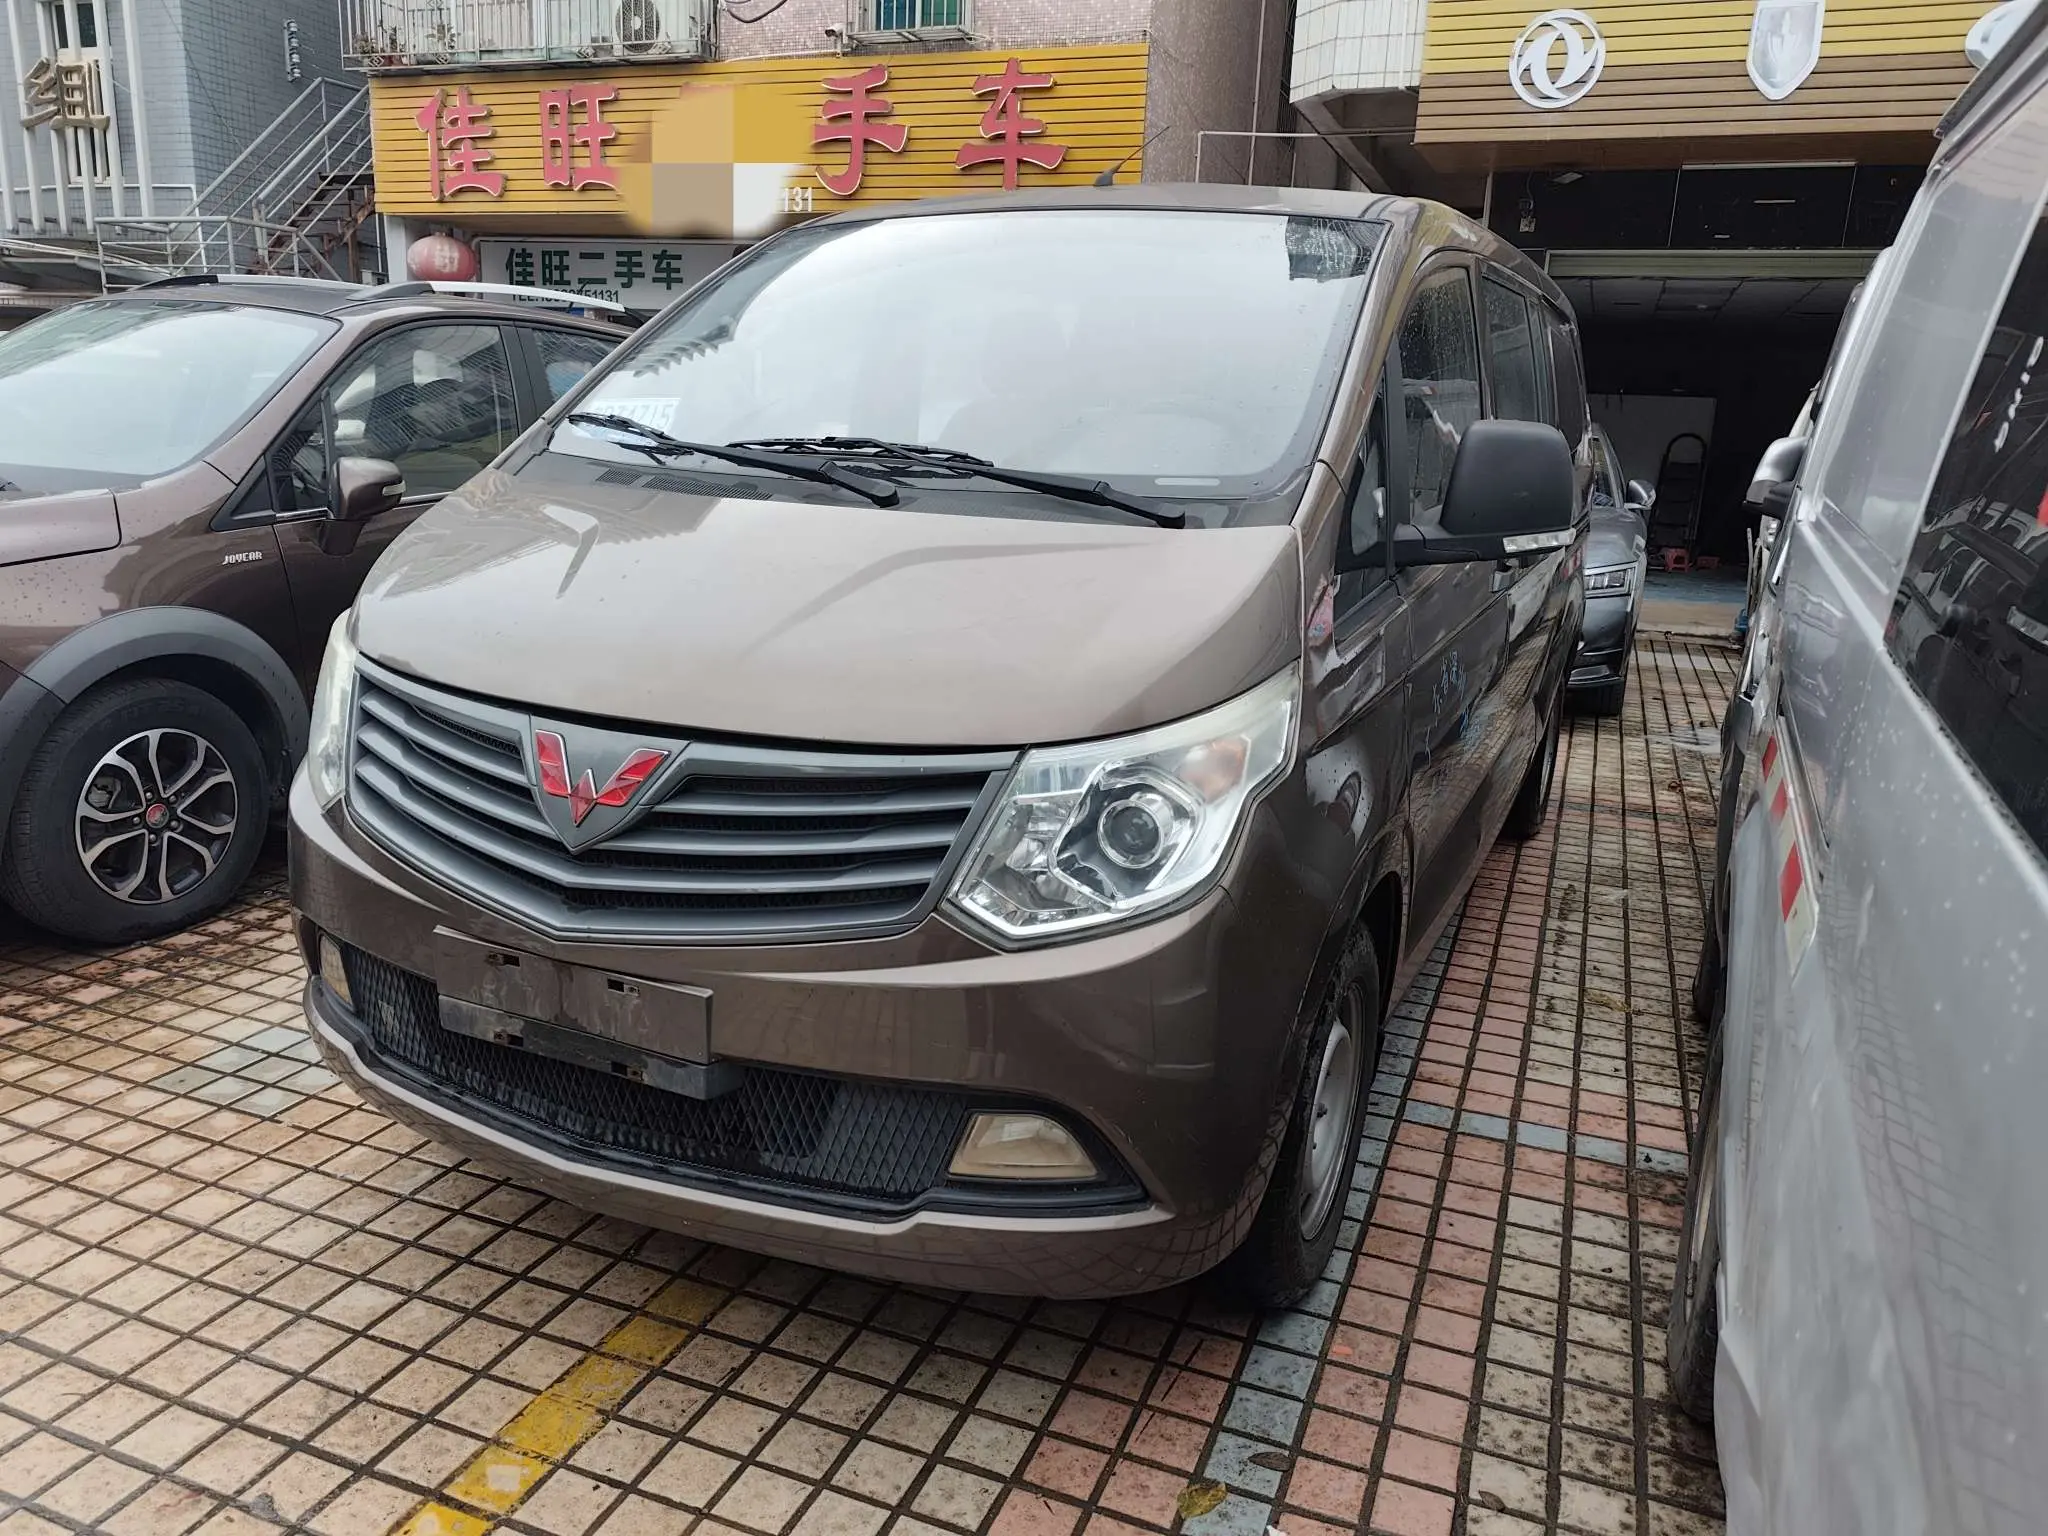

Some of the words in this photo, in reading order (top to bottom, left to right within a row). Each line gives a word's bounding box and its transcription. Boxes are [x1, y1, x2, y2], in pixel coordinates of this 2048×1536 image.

[414, 57, 1068, 201] 佳旺手车
[505, 247, 684, 291] 佳旺二手车
[222, 551, 263, 565] JOYEAR
